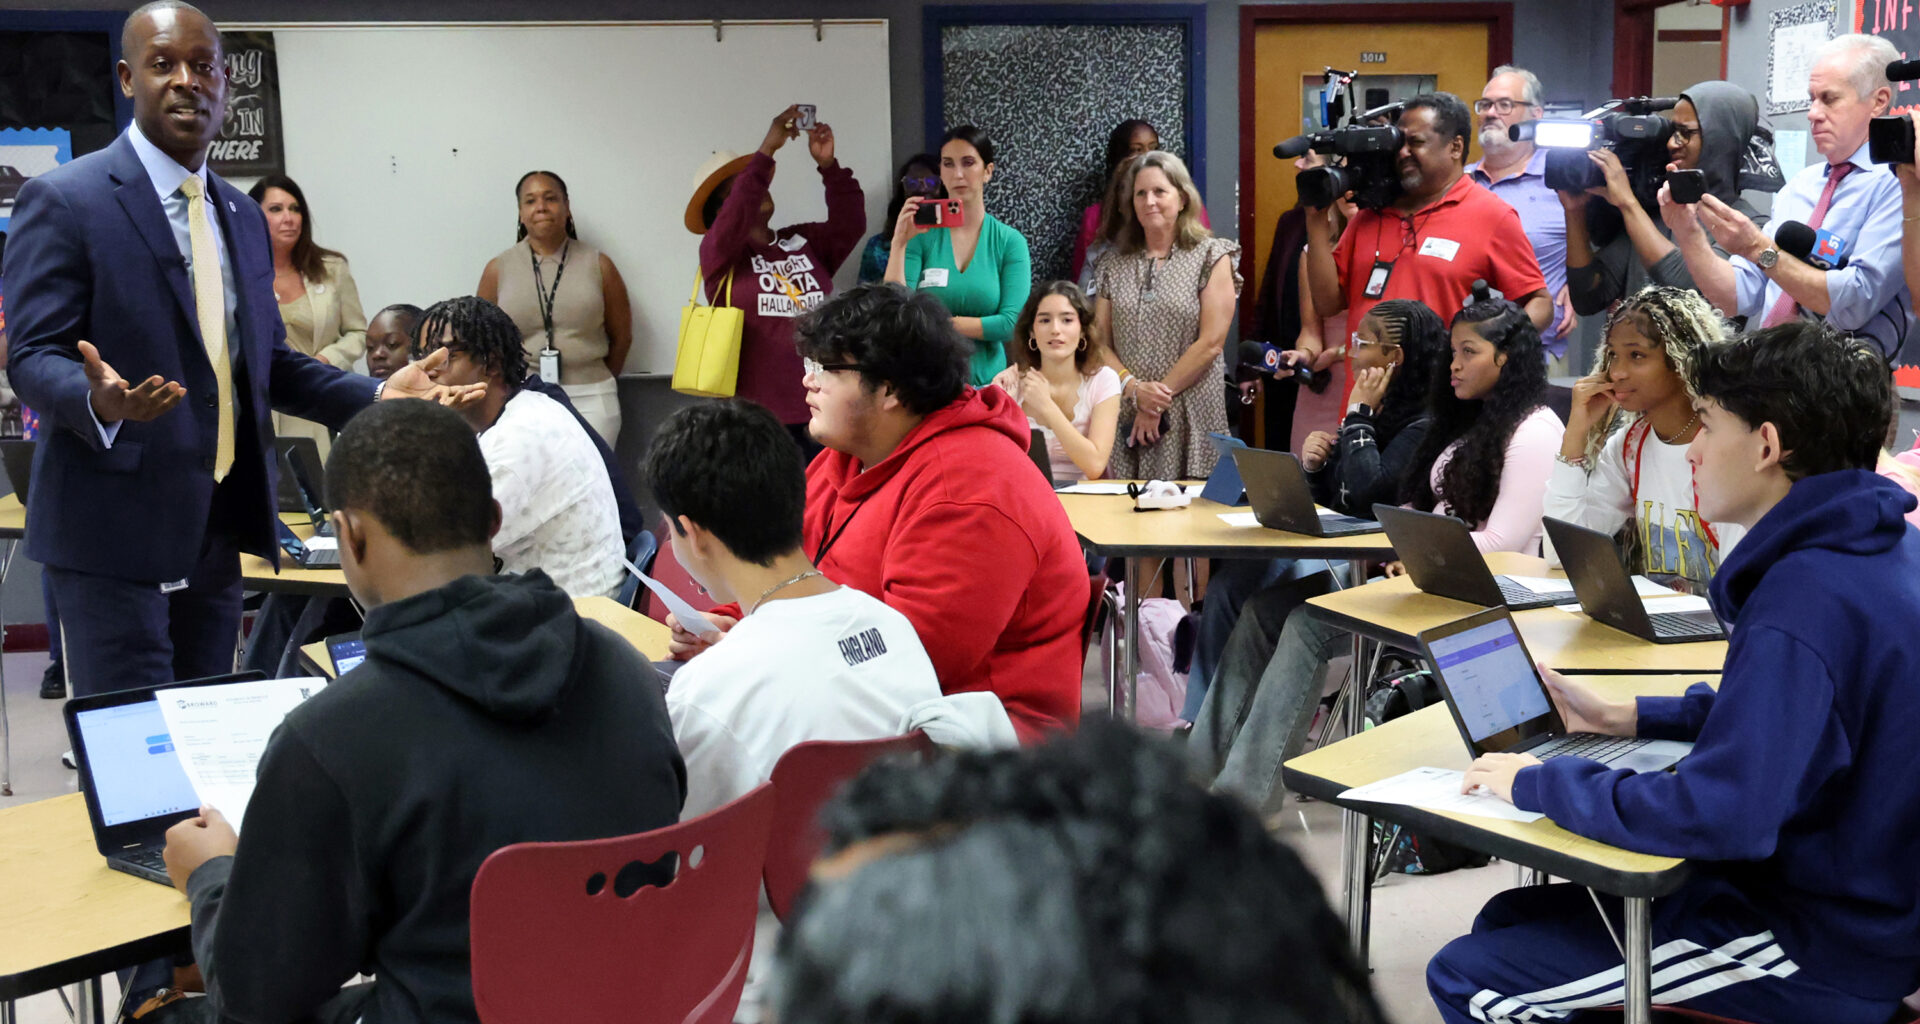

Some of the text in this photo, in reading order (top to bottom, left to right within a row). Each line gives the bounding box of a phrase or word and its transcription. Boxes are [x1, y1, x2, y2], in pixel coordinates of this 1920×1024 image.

[1872, 0, 1920, 34] INF
[237, 108, 264, 136] IN
[205, 140, 263, 160] THERE
[1636, 499, 1716, 580] LLEY
[837, 627, 888, 666] ENGLAND
